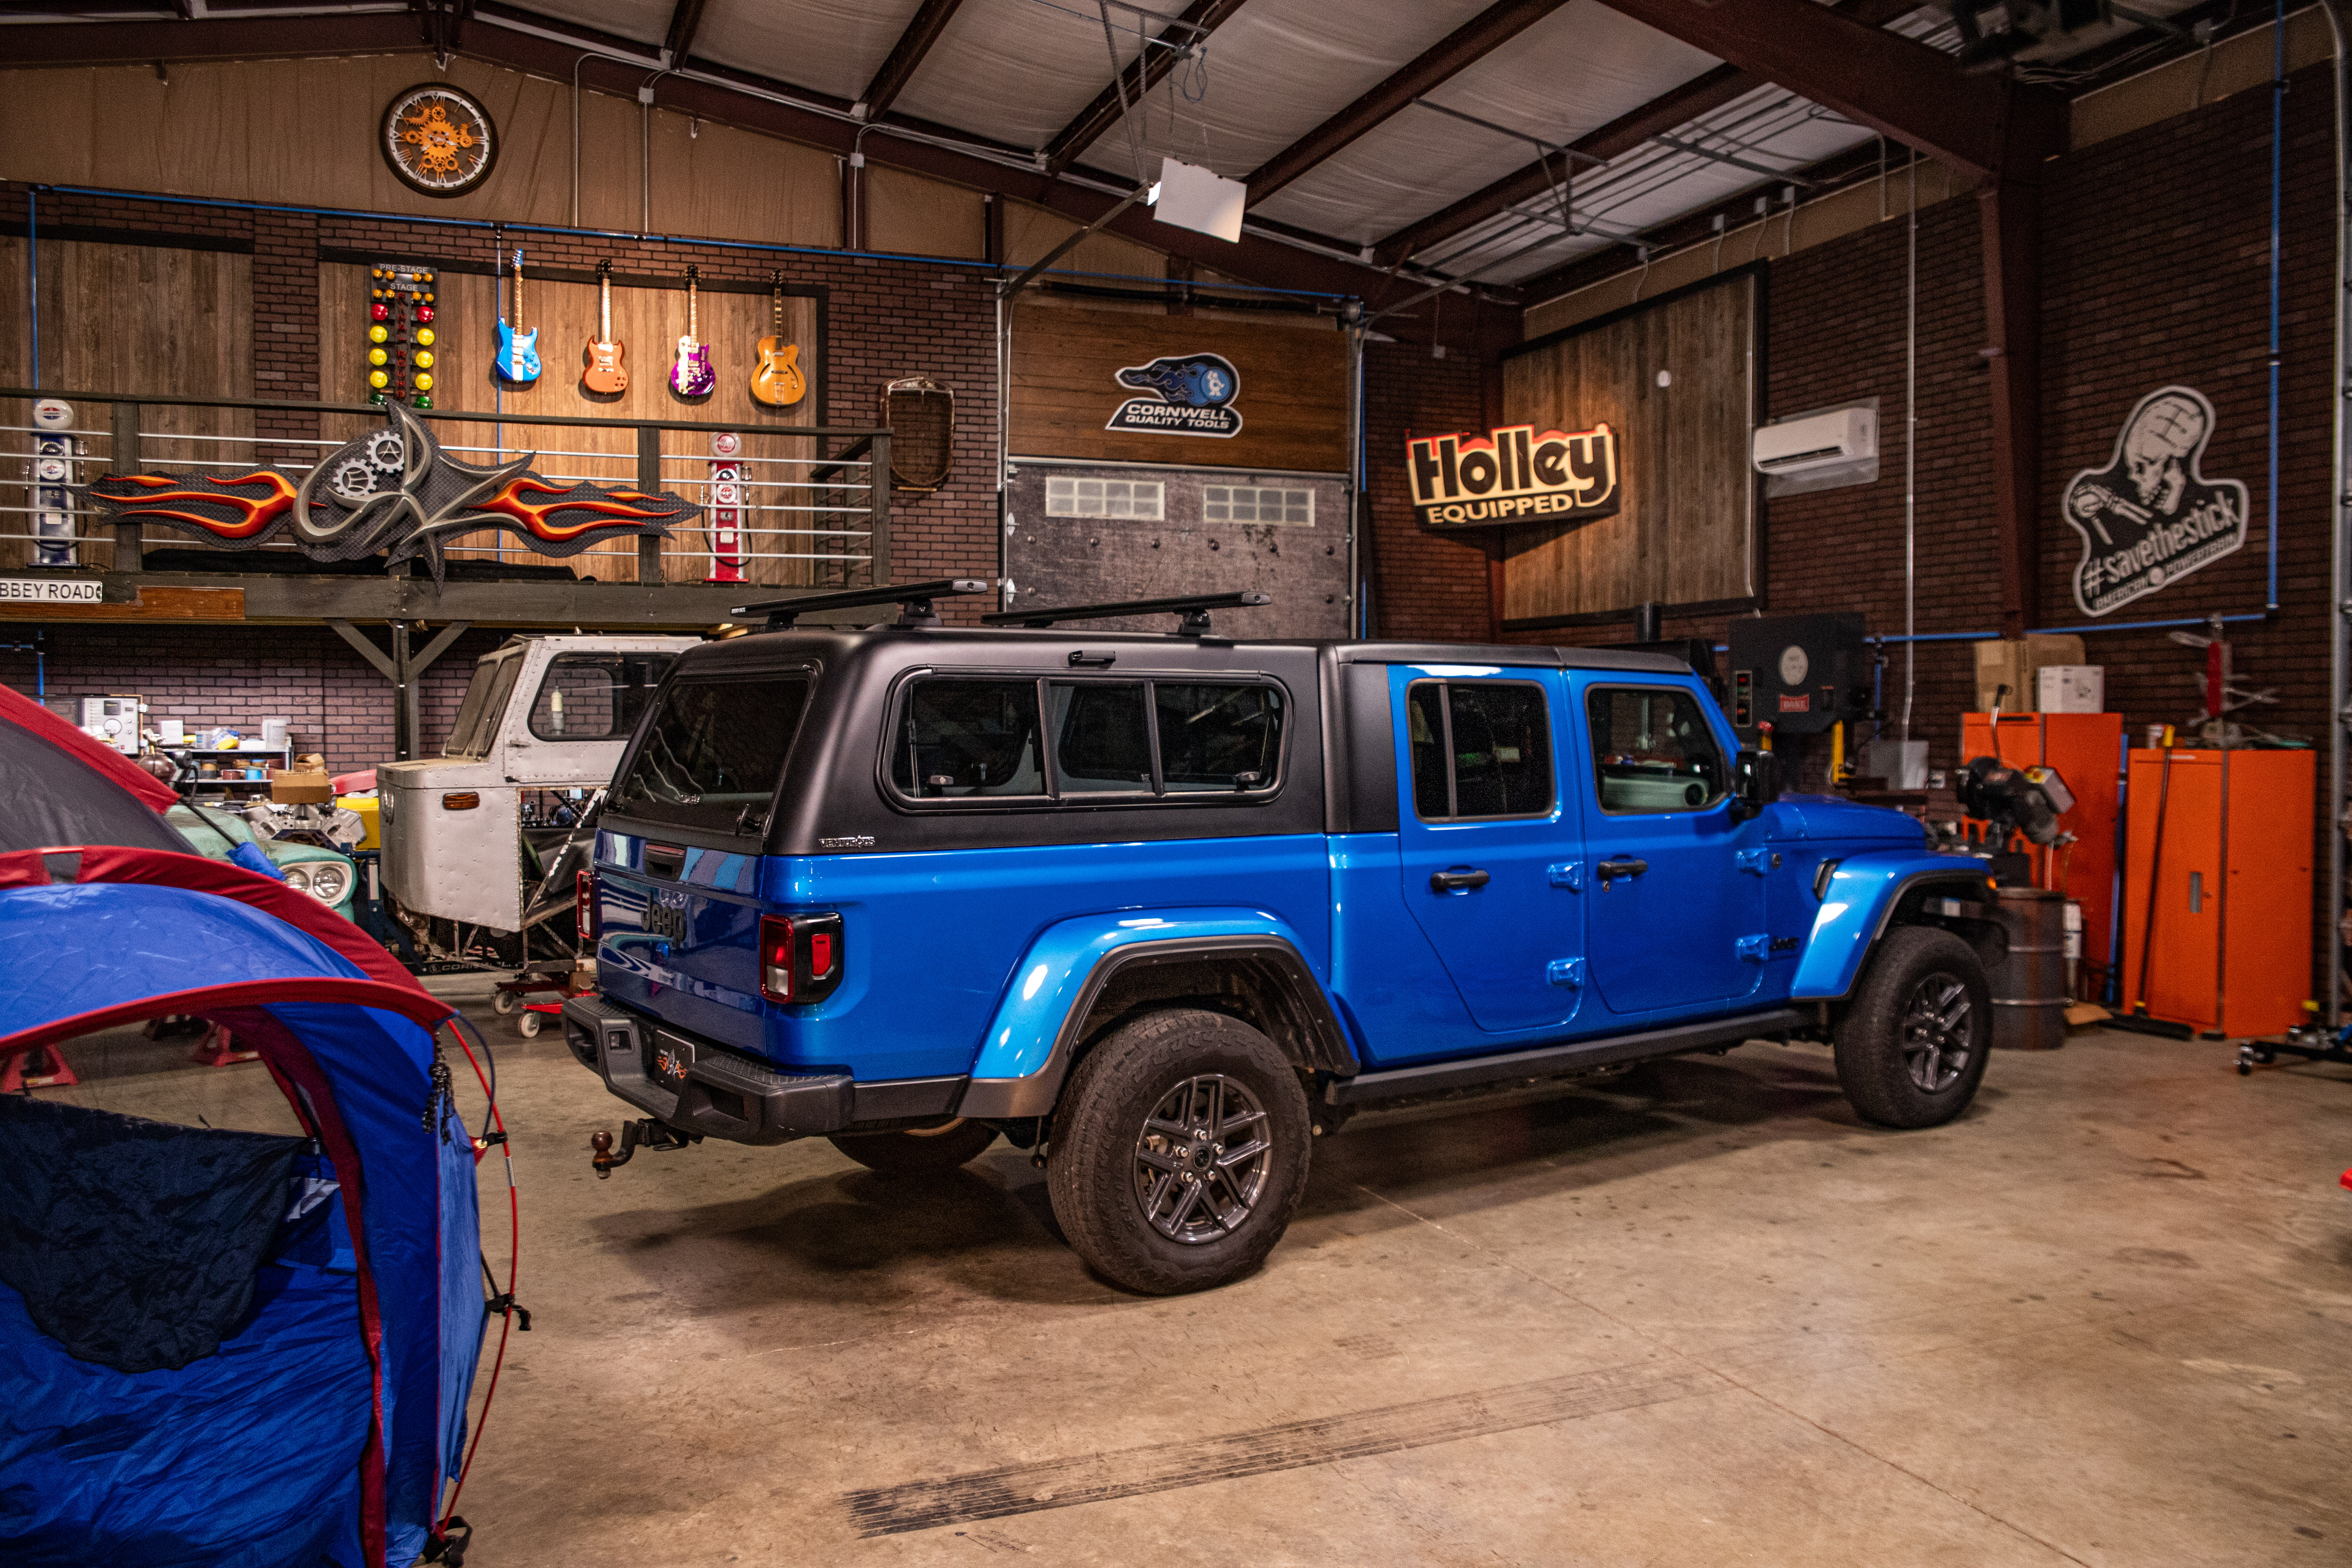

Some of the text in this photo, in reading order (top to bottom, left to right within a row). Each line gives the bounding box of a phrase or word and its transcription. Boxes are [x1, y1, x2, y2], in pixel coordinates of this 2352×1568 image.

[380, 264, 428, 274] PRE-STAGE
[390, 283, 418, 291] STAGE
[397, 350, 406, 398] ROUND
[1125, 415, 1231, 429] QUALITY TOOLS
[1127, 404, 1227, 421] CORNWELL
[1412, 429, 1609, 505] Holley
[1427, 493, 1573, 524] EQUIPPED
[2082, 490, 2240, 599] #savethestick
[0, 582, 95, 599] BBEY ROAD
[641, 890, 687, 948] Jeep
